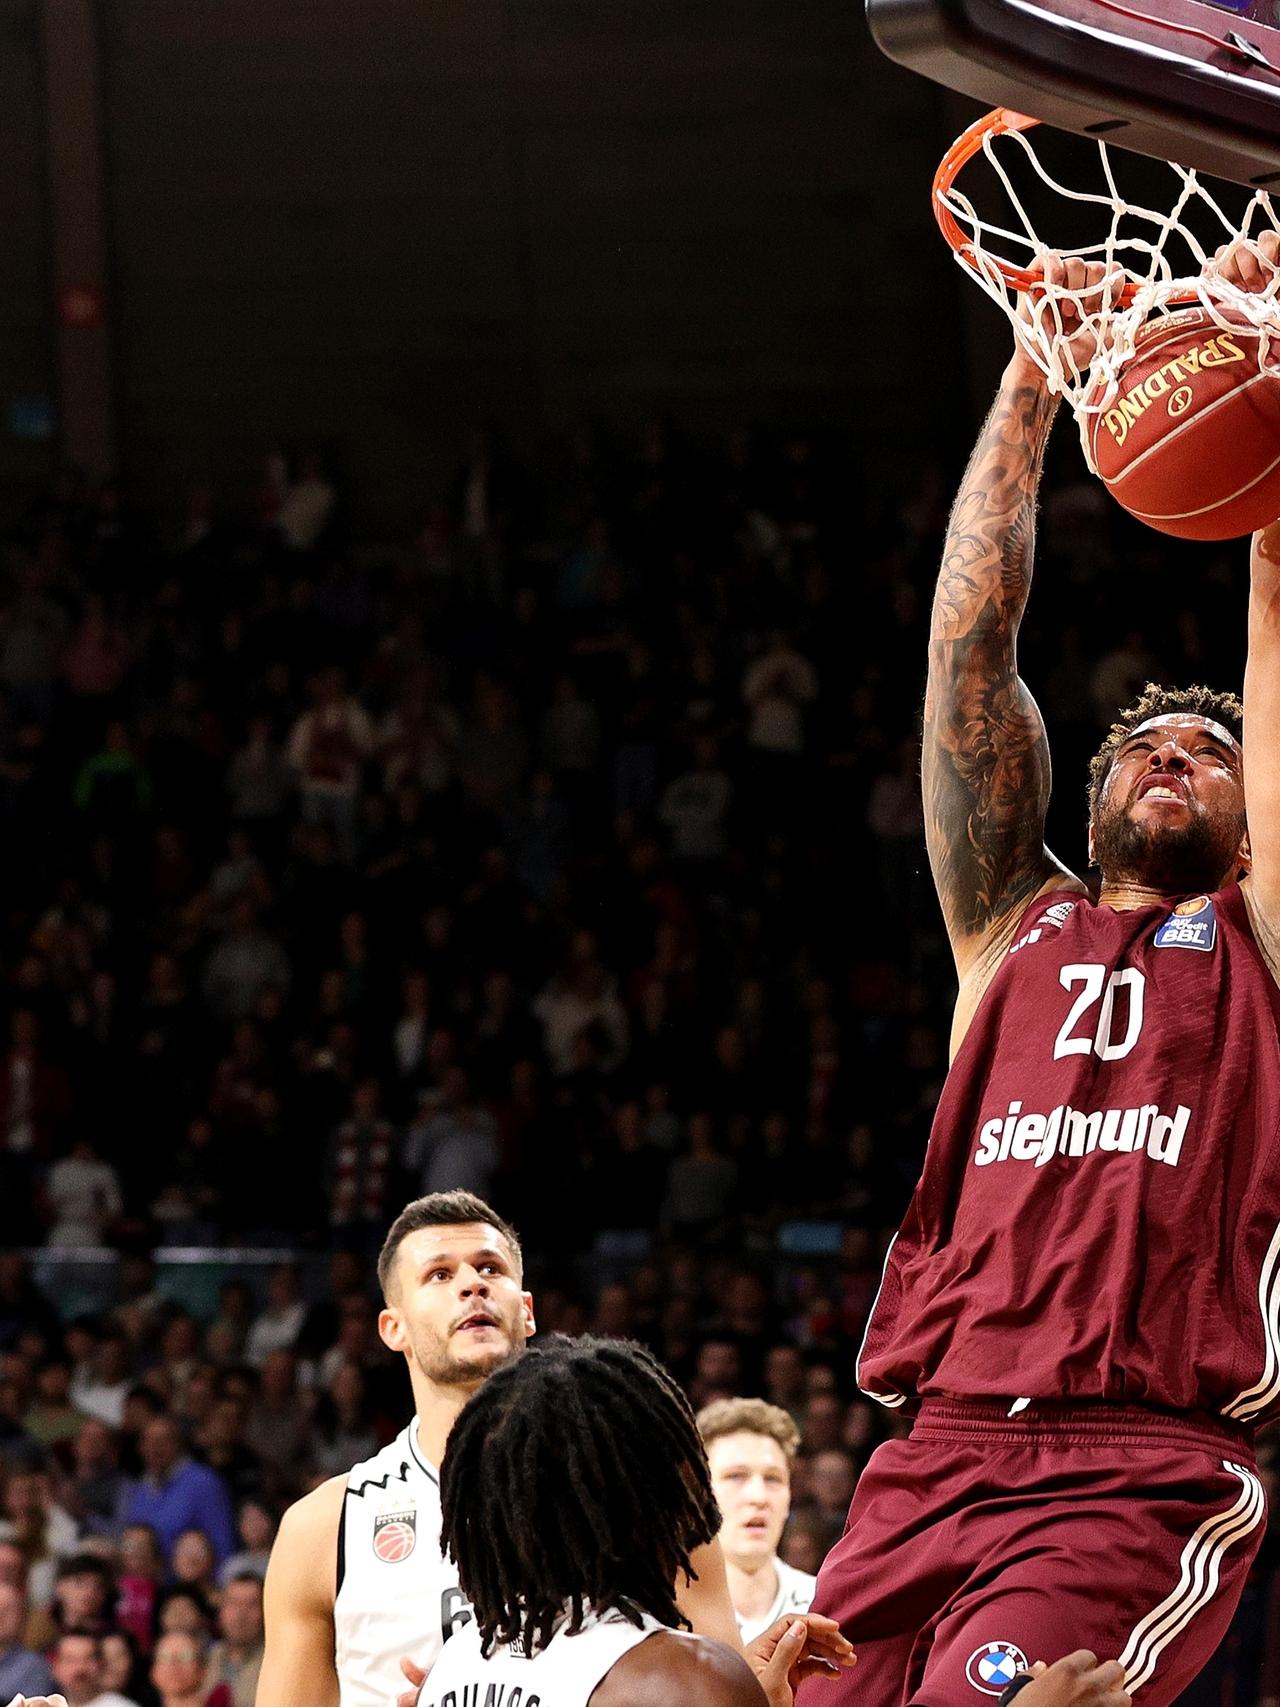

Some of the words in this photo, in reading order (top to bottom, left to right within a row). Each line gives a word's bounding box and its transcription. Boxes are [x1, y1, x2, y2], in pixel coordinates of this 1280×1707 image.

[1101, 333, 1246, 446] SPALDING
[1160, 929, 1206, 945] BBL
[1053, 963, 1146, 1062] 20
[988, 1644, 1025, 1672] BMW
